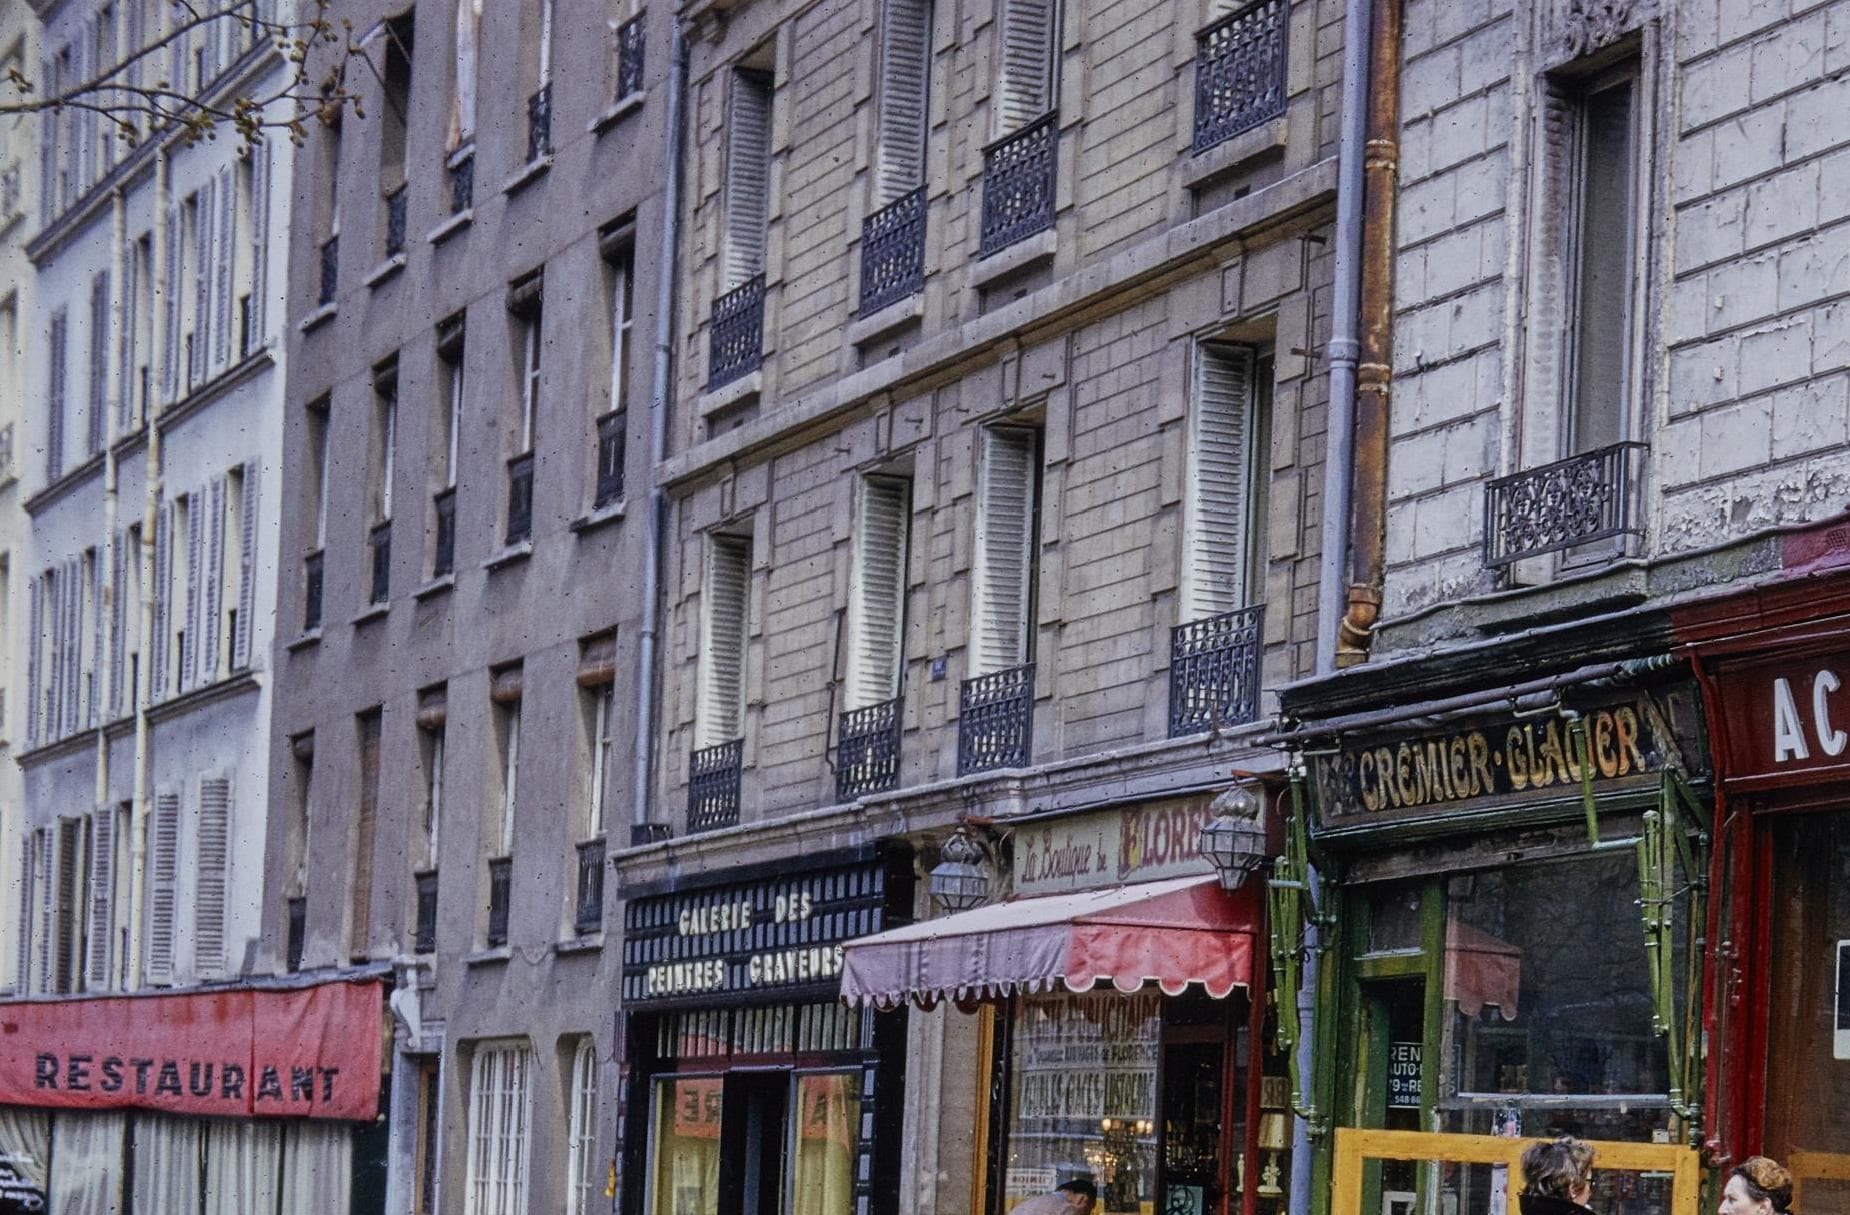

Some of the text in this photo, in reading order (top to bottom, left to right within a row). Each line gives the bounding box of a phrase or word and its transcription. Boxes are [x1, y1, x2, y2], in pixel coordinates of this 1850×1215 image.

[1118, 803, 1212, 880] FLORE
[679, 892, 812, 936] GALERIE DES
[649, 944, 844, 993] PEINTRES GRAVEURS
[35, 1052, 339, 1102] RESTAURANT
